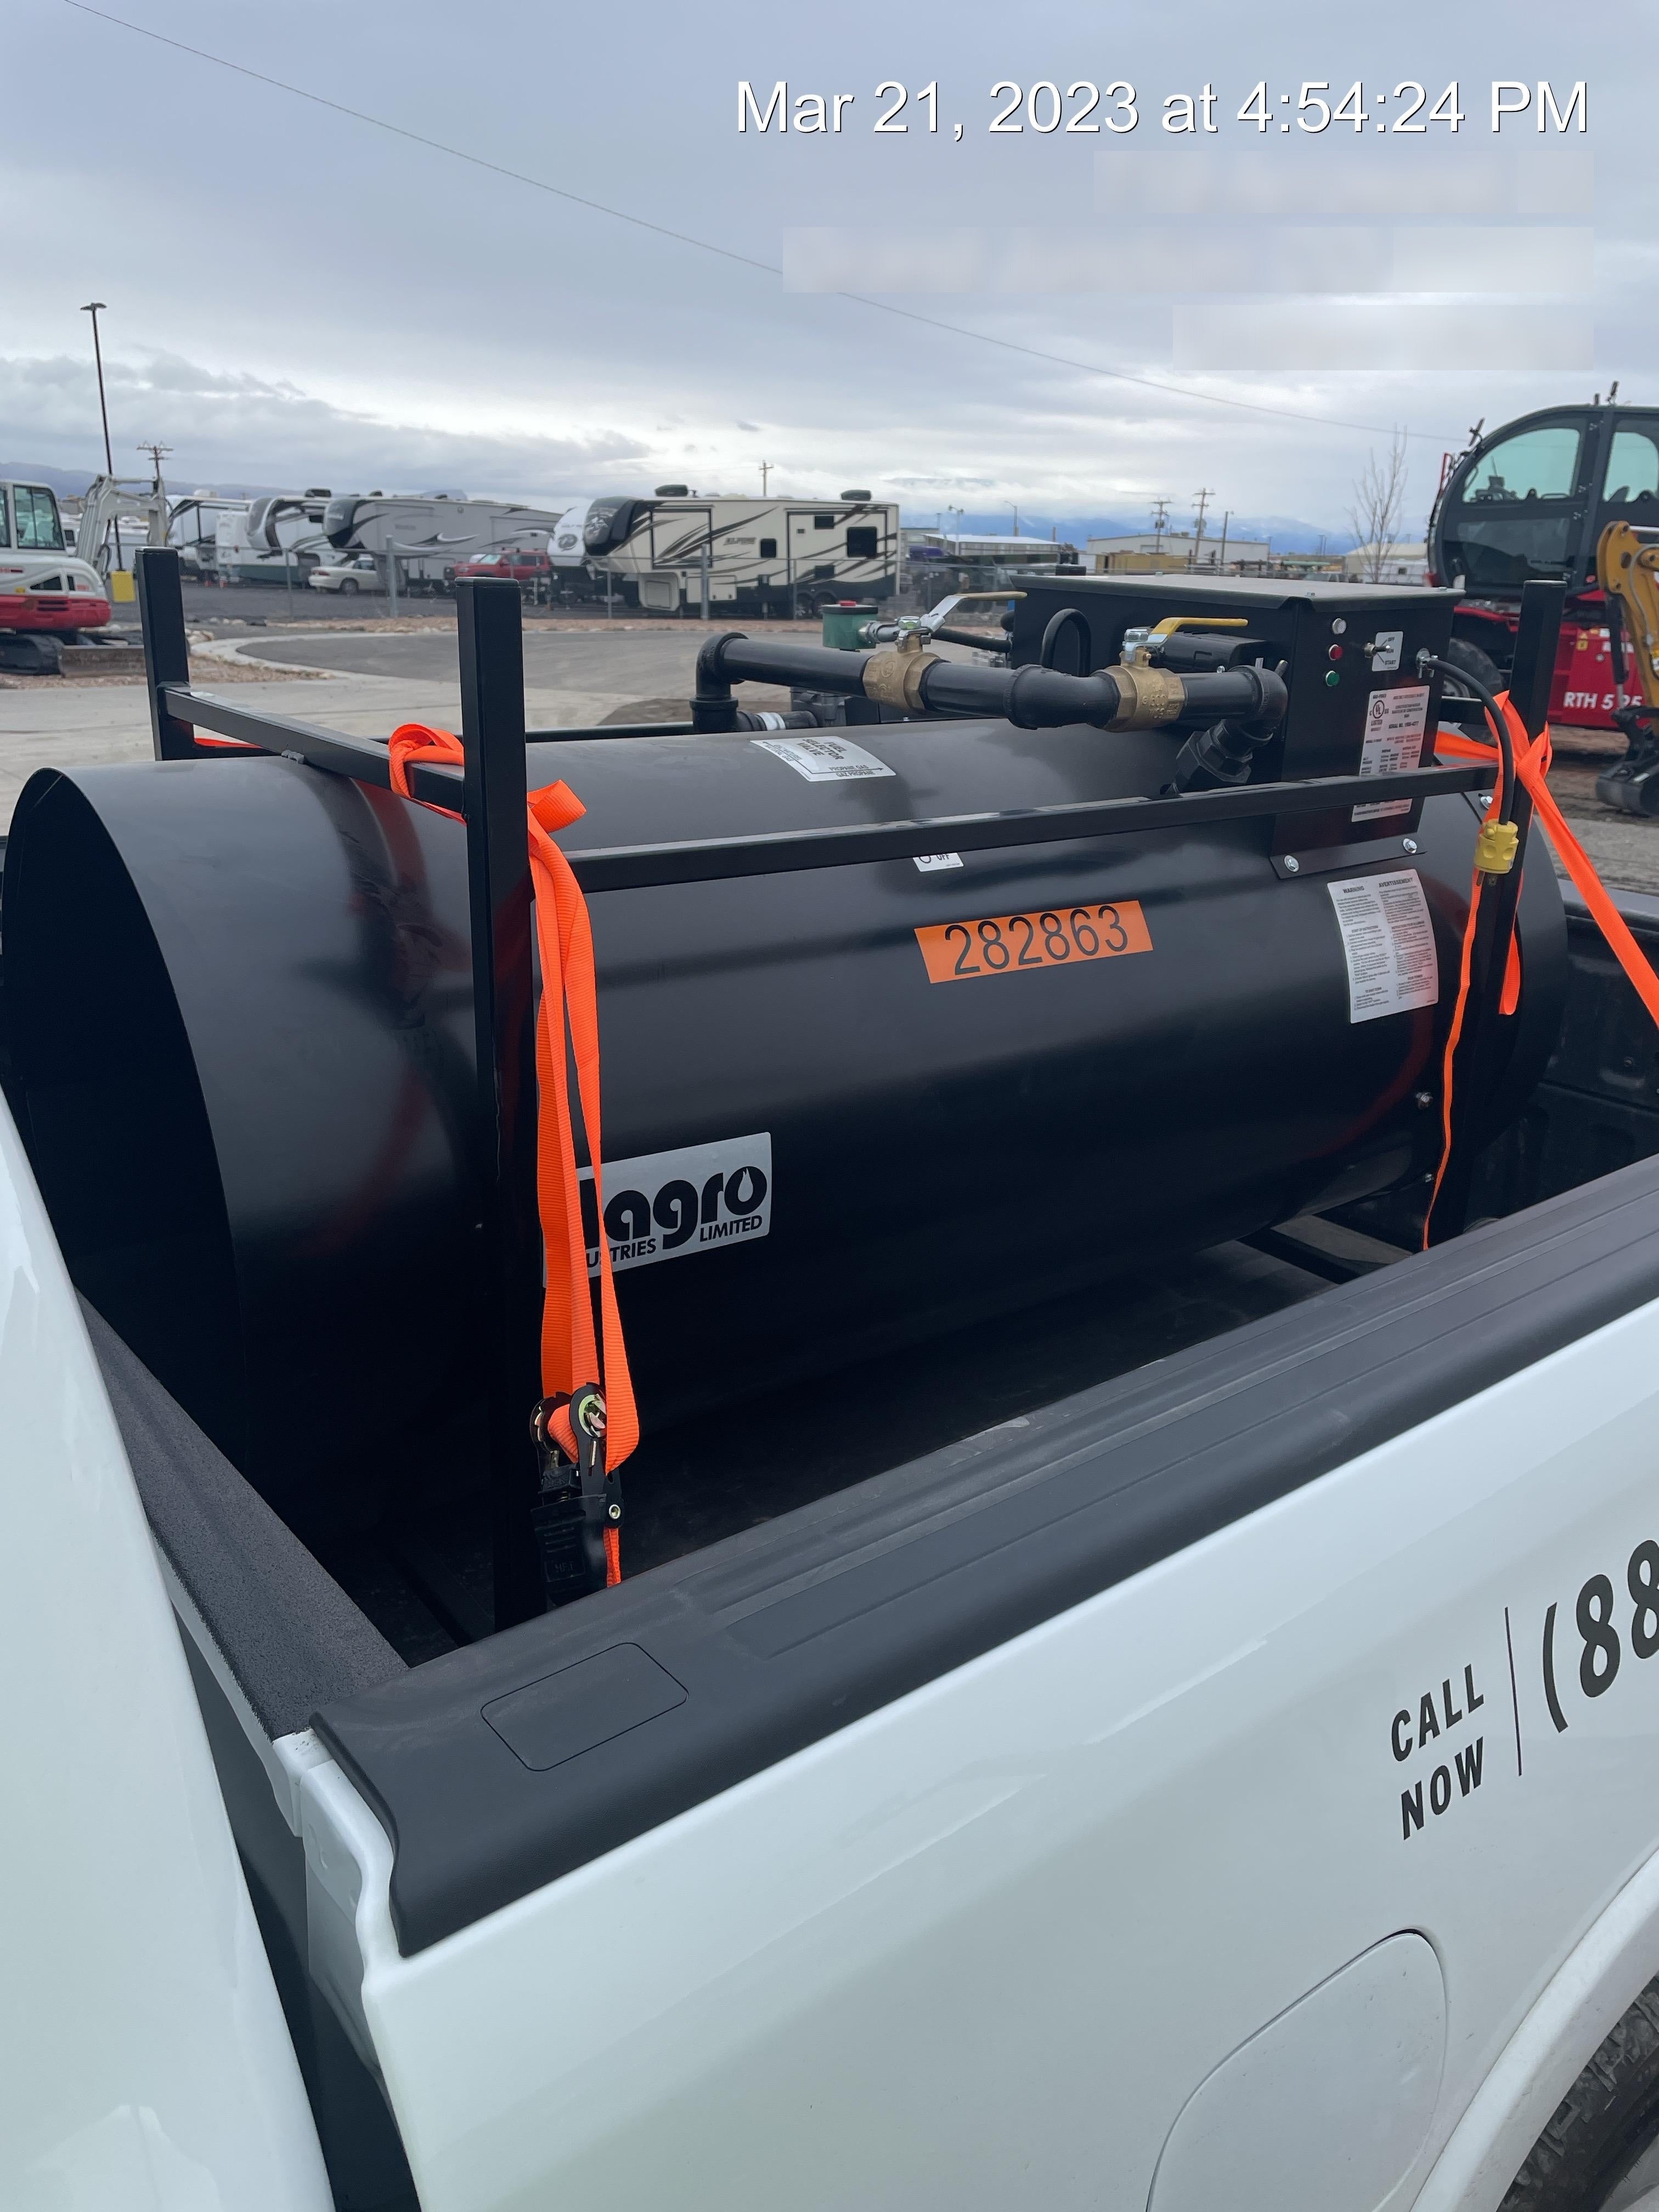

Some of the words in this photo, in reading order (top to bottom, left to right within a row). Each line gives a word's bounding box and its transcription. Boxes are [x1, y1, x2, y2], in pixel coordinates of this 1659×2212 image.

[1563, 691, 1598, 709] RTH
[797, 742, 825, 755] VALVE
[803, 739, 844, 760] SELECTOR
[824, 742, 847, 753] FUEL
[1342, 885, 1364, 894] WARNING
[1378, 877, 1413, 888] AVERTISSEMENT
[945, 905, 1128, 976] 282863
[579, 1166, 768, 1250] lagro
[699, 1215, 762, 1243] LIMITED
[1391, 1663, 1484, 1762] CALL
[1401, 1736, 1484, 1841] NOW
